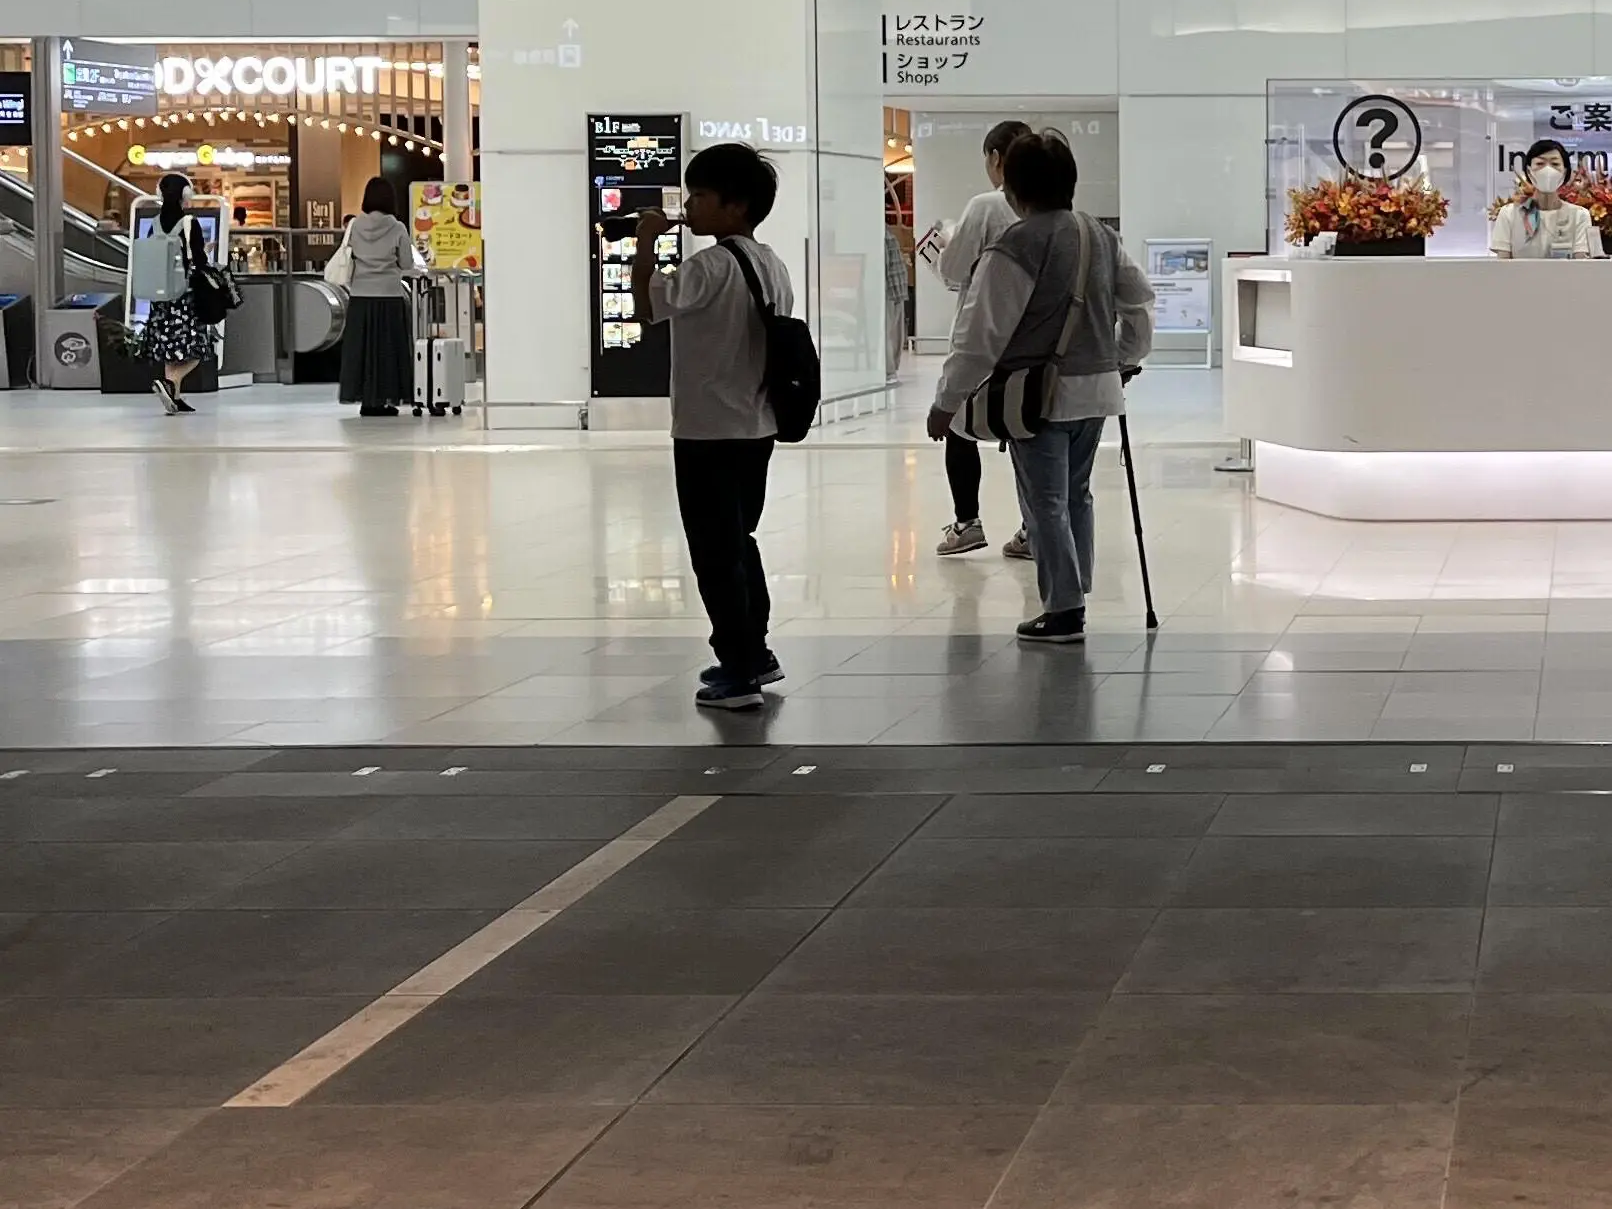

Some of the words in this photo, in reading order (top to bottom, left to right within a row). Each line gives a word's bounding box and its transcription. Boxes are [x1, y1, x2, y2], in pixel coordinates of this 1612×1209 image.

[896, 14, 985, 32] レストラン
[896, 34, 981, 47] Restaurants
[897, 52, 969, 70] ショップ
[897, 71, 939, 86] Shops
[594, 116, 620, 134] B1F
